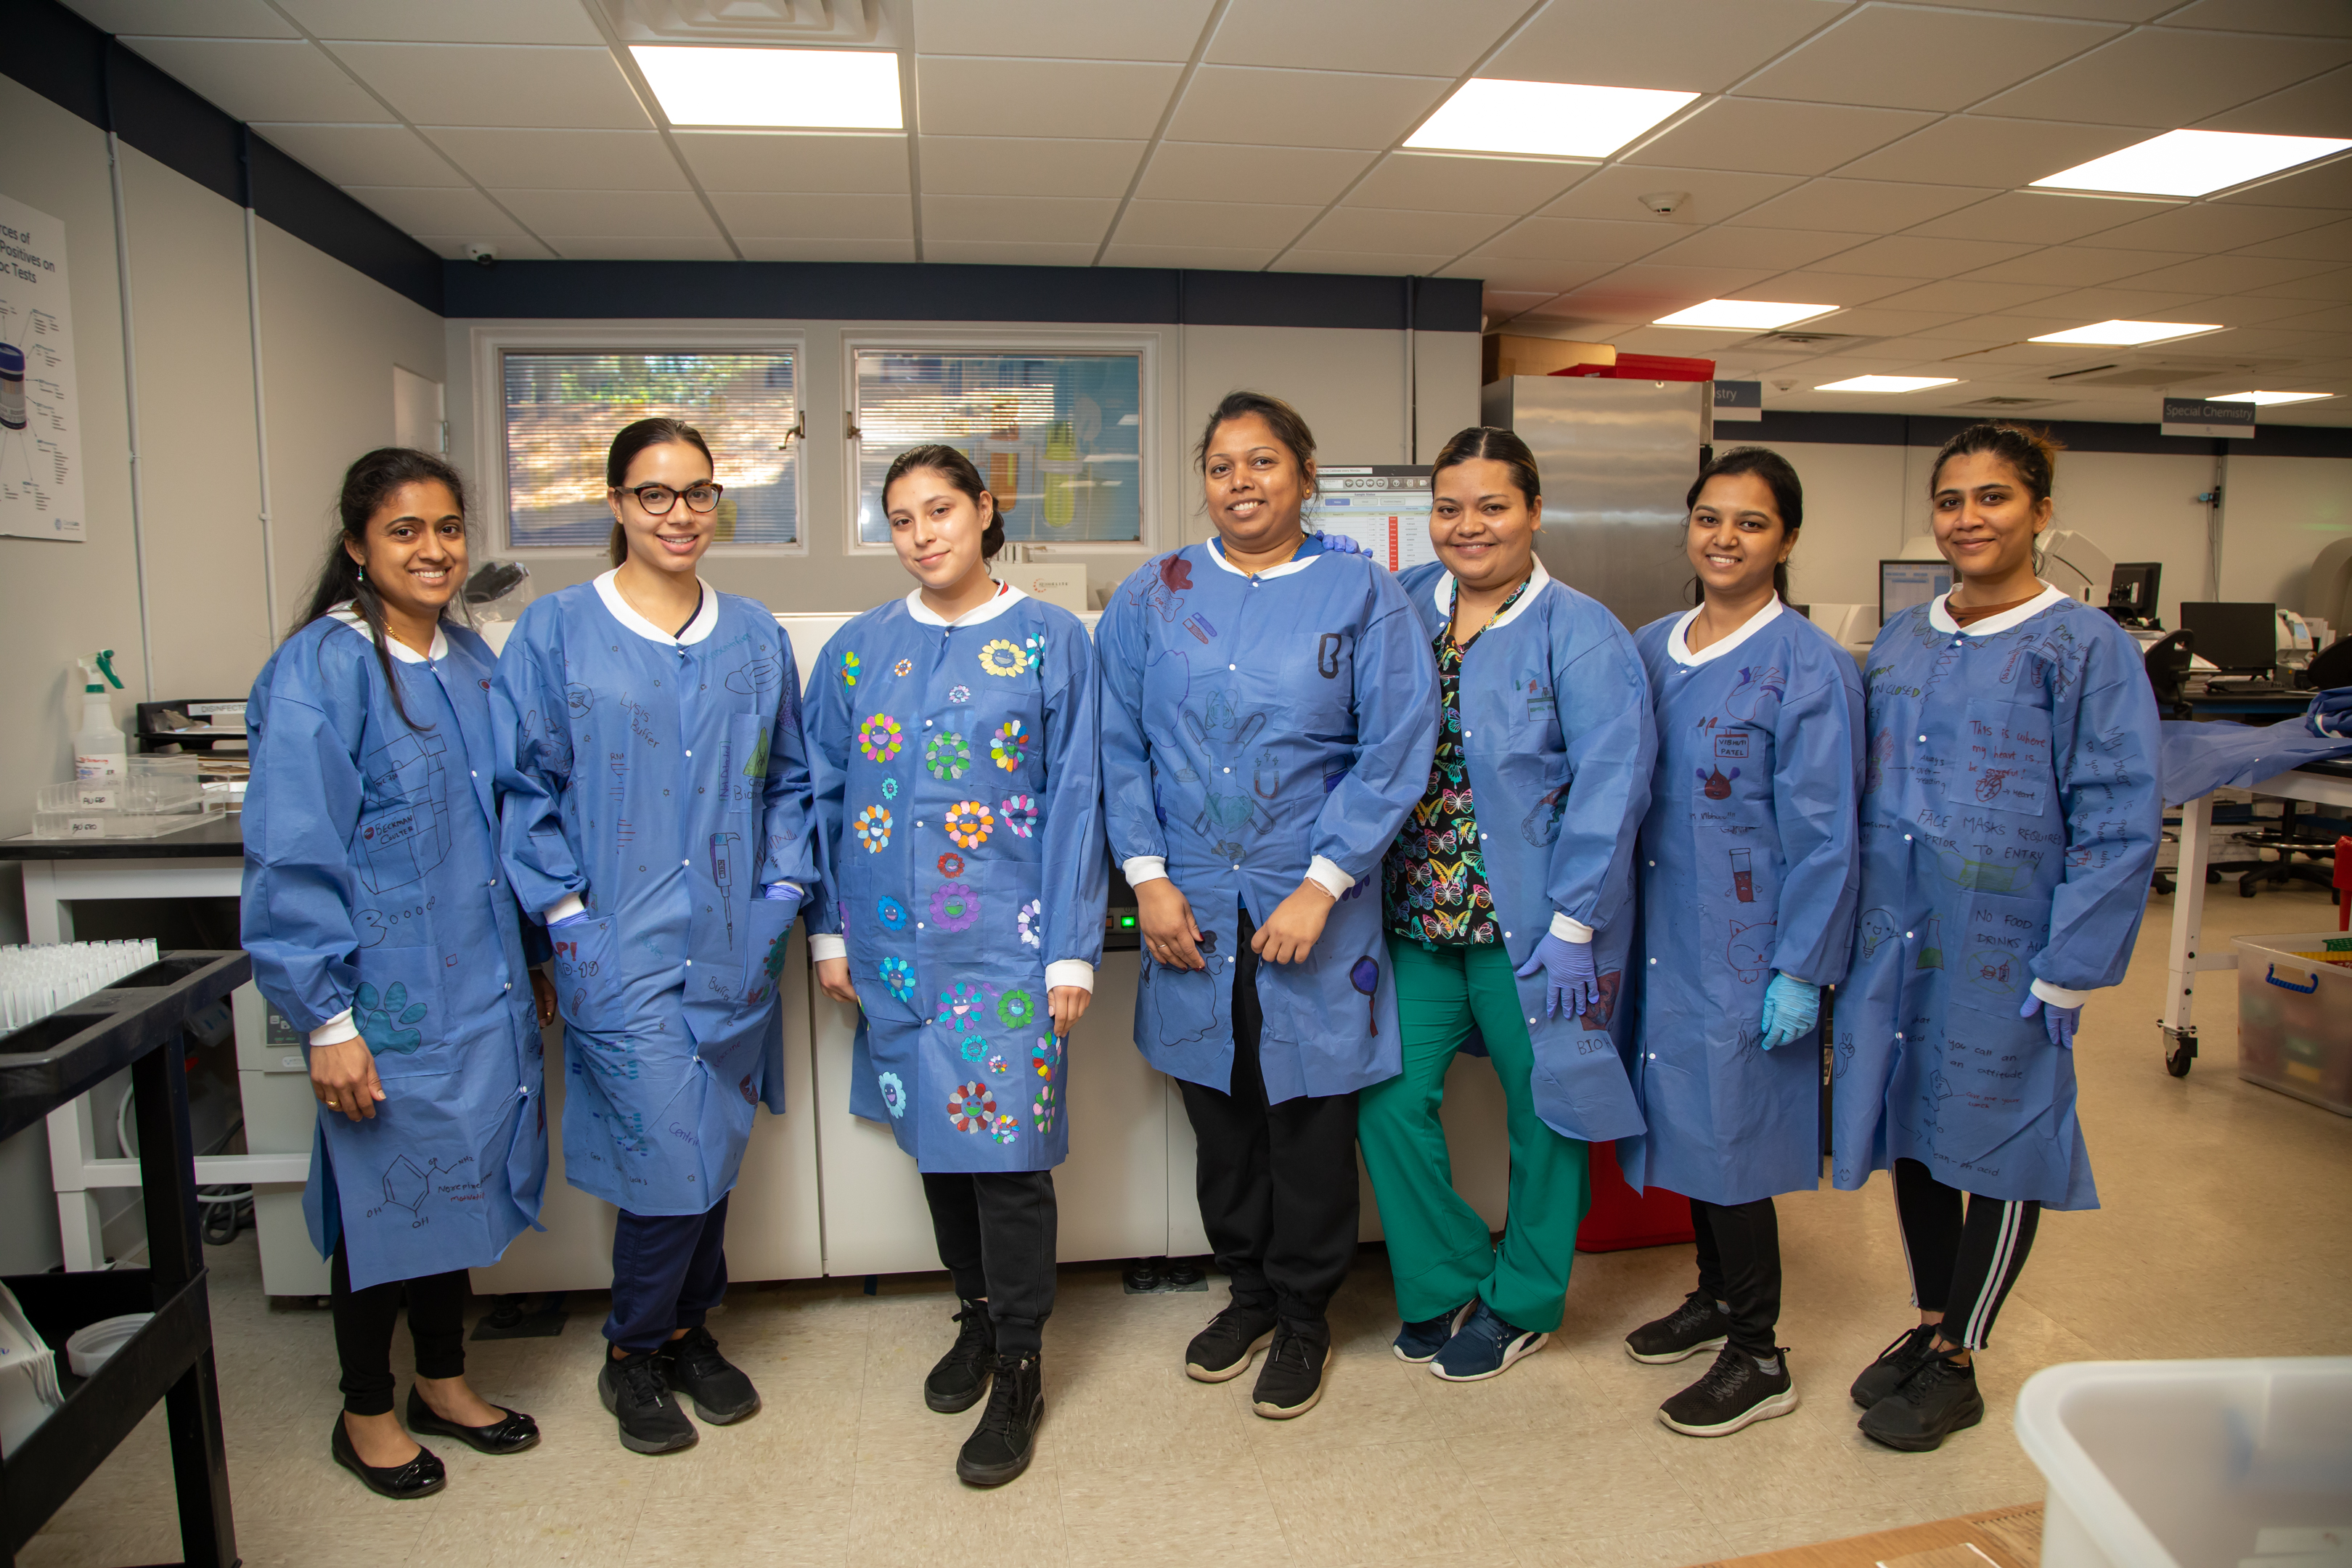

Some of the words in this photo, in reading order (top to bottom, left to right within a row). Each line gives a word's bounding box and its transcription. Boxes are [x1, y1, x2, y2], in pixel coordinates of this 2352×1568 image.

[20, 232, 30, 245] of
[0, 240, 41, 267] Positives
[44, 260, 55, 272] on
[11, 262, 36, 283] Tests
[2166, 404, 2200, 417] Special
[2203, 407, 2253, 420] Chemistry
[620, 691, 650, 722] Lysis
[630, 718, 661, 748] Buffer
[1969, 720, 1993, 736] This
[2001, 728, 2009, 739] is
[2100, 725, 2125, 751] My
[1972, 745, 1986, 760] my
[1993, 746, 2017, 760] heart
[1968, 761, 1979, 772] be
[2085, 759, 2100, 777] you
[375, 814, 413, 836] BECKMAN
[380, 825, 414, 844] COULTER
[1916, 809, 1953, 828] FACE
[1963, 817, 2006, 836] MASKS
[2017, 826, 2062, 846] REQUIRED
[1924, 831, 1960, 853] PRIOR
[1973, 844, 1993, 856] TO
[2004, 846, 2044, 870] ENTRY
[1976, 910, 1993, 923] NO
[2004, 915, 2033, 929] FOOD
[1977, 933, 2021, 948] DRINKS
[708, 976, 731, 1001] Buffer
[1948, 1039, 1967, 1051] you
[1974, 1048, 1992, 1056] call
[1977, 1067, 2023, 1079] attitude
[1977, 1166, 2001, 1177] acid
[367, 1206, 383, 1218] OH
[412, 1216, 430, 1229] OH
